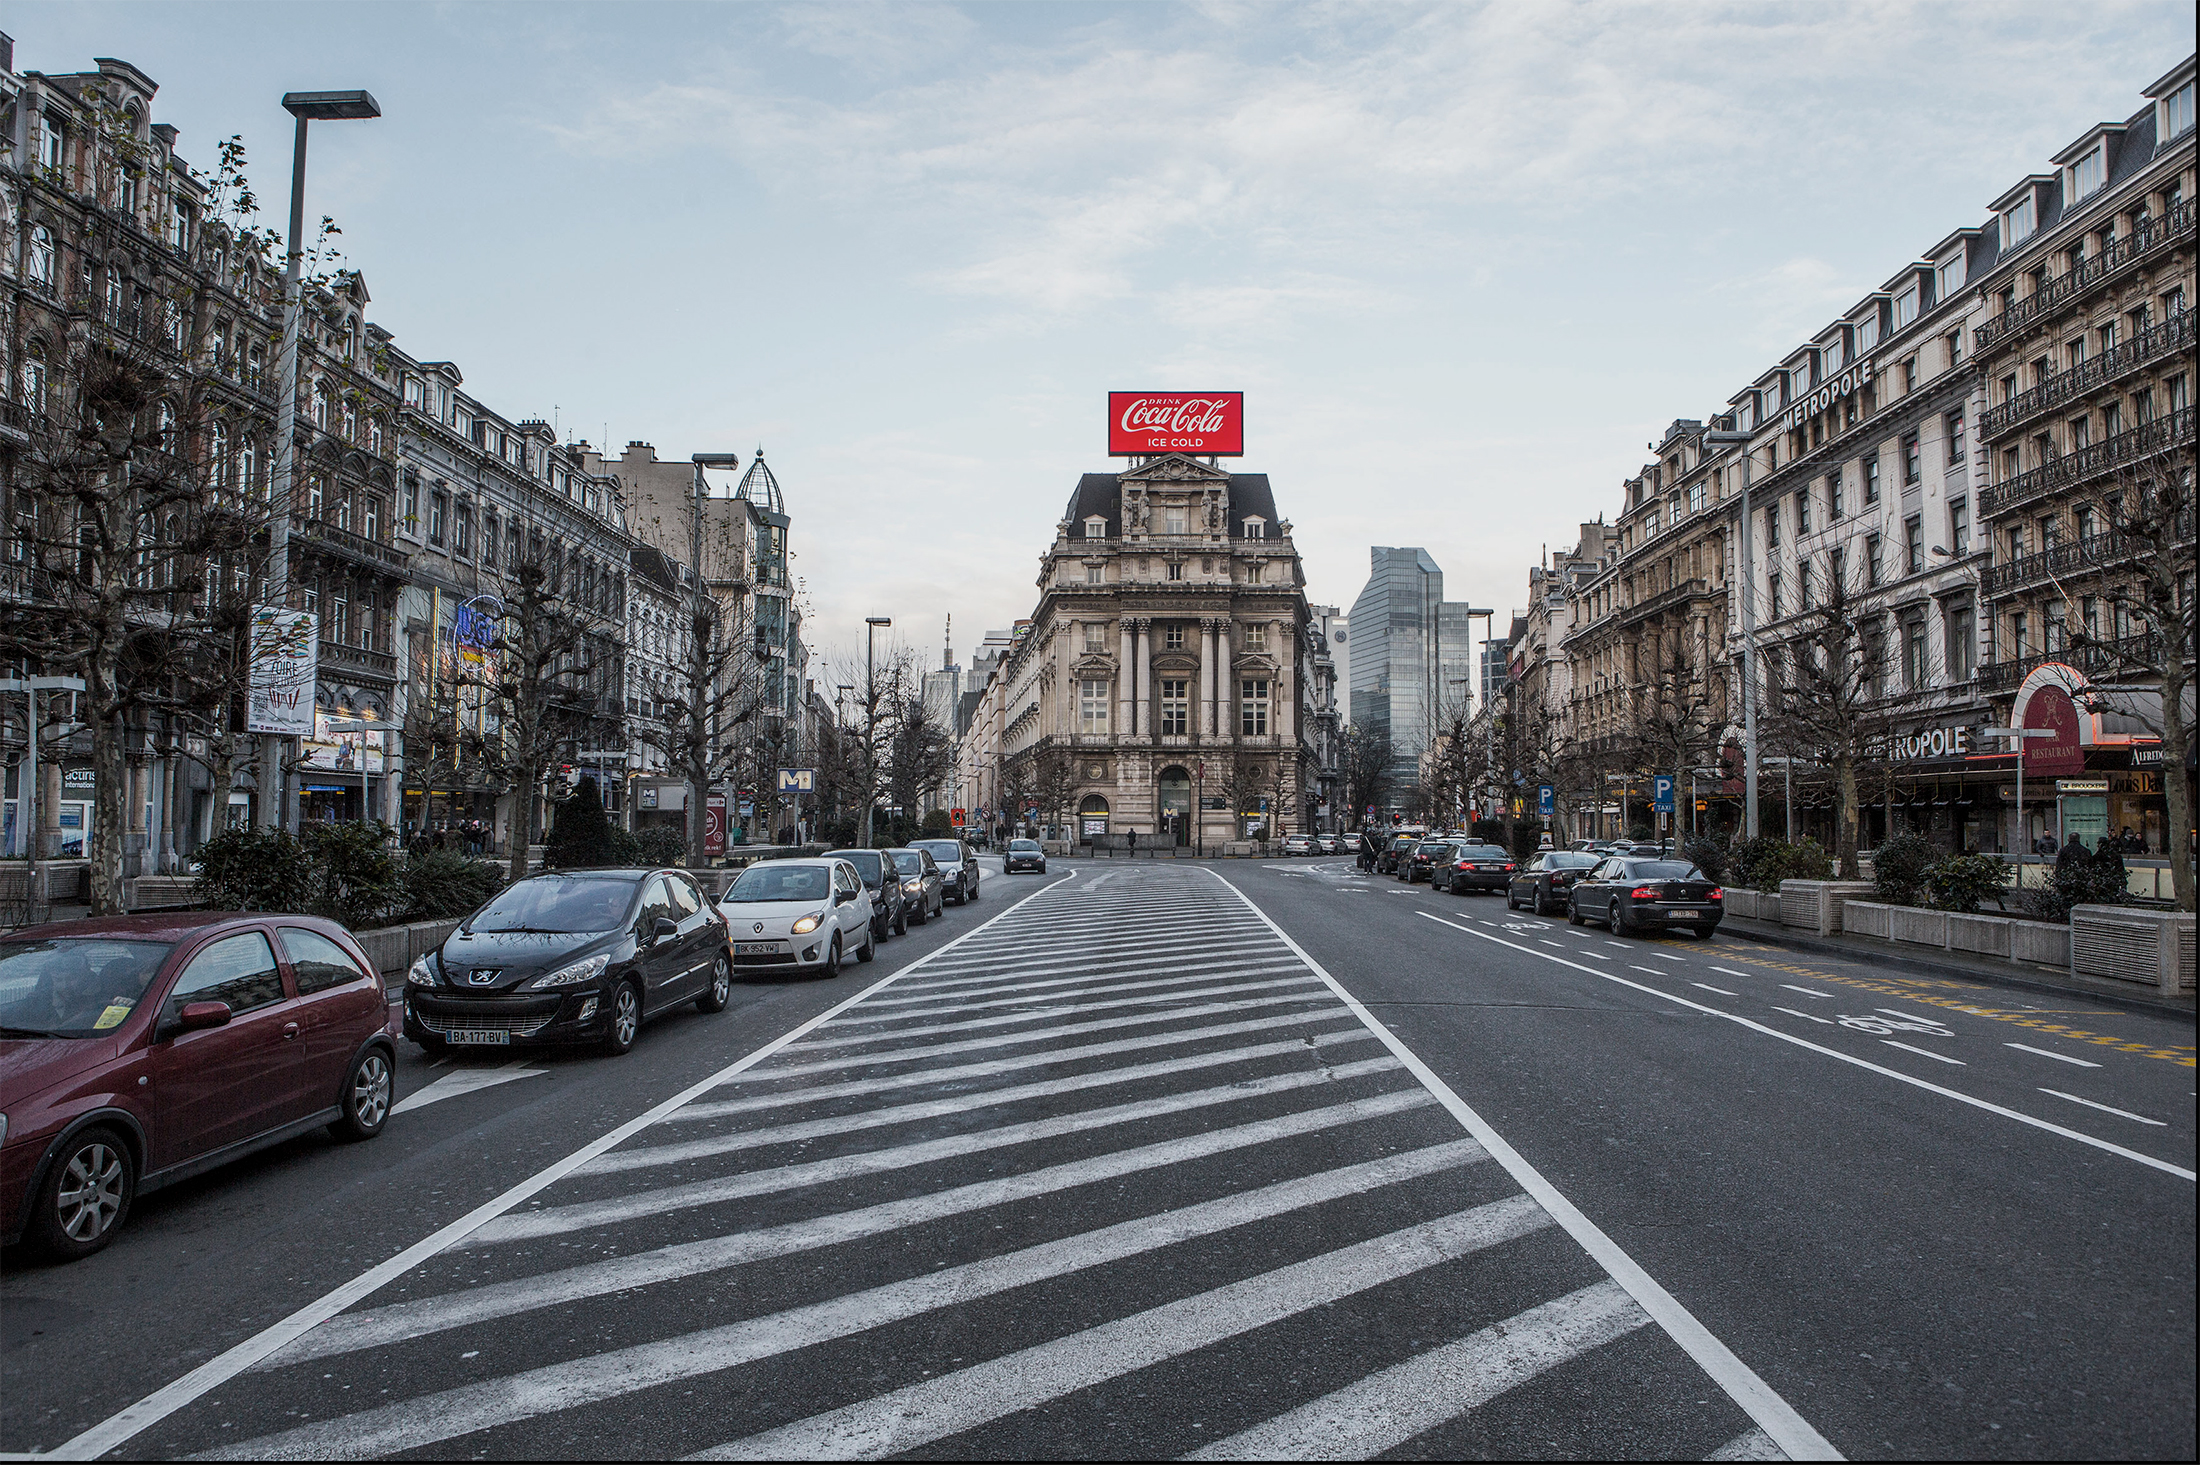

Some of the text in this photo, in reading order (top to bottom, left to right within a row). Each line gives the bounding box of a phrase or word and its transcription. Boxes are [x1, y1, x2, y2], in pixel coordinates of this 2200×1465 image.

[1784, 359, 1872, 433] METROPOLE
[1121, 398, 1230, 433] Coca-Cola
[1148, 438, 1204, 447] ICE COLD
[271, 660, 299, 677] FOIRE
[2031, 746, 2075, 760] RESTAURANT
[779, 770, 812, 790] M
[2108, 775, 2139, 793] Louis
[1541, 788, 1552, 803] P
[1657, 779, 1671, 799] P
[453, 1031, 501, 1042] BA-177-BV
